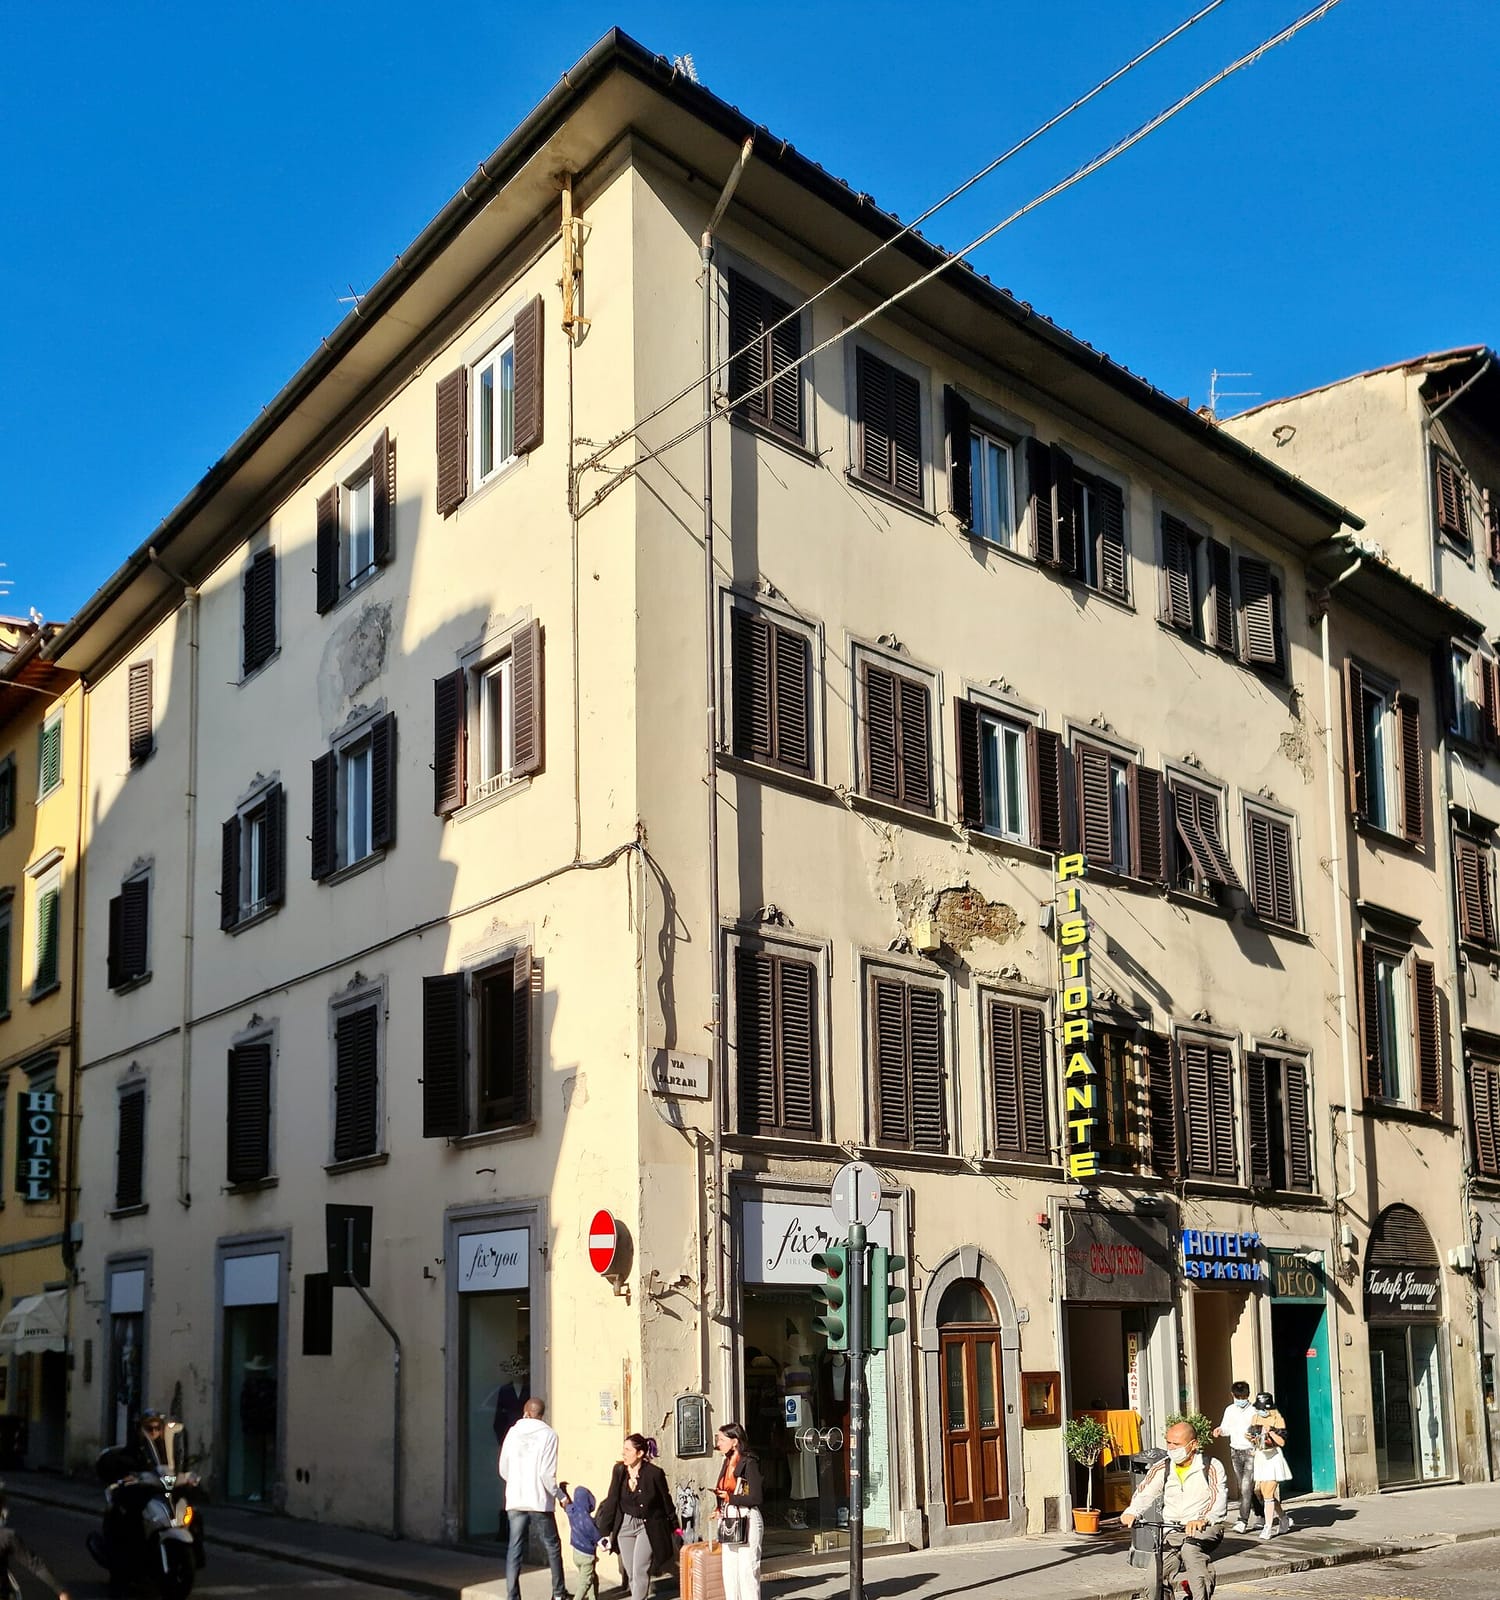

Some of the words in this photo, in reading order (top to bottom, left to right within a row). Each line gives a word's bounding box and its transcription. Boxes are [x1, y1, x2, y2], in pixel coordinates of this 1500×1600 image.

[1058, 852, 1097, 1178] RISTORANTE
[671, 1059, 685, 1069] VIA
[659, 1074, 697, 1088] PANZANI
[26, 1091, 56, 1201] HOTEL
[766, 1216, 818, 1271] fix
[1185, 1229, 1247, 1257] HOTEL
[465, 1243, 489, 1281] fix
[492, 1252, 519, 1278] you
[785, 1258, 811, 1266] FIREN
[1117, 1244, 1144, 1276] ROSSO
[1187, 1260, 1265, 1281] SPAGNA
[1277, 1271, 1316, 1296] DECO
[1364, 1270, 1402, 1303] Tartufi
[1400, 1272, 1437, 1303] Jimmy
[1129, 1334, 1138, 1401] RISTORANTE
